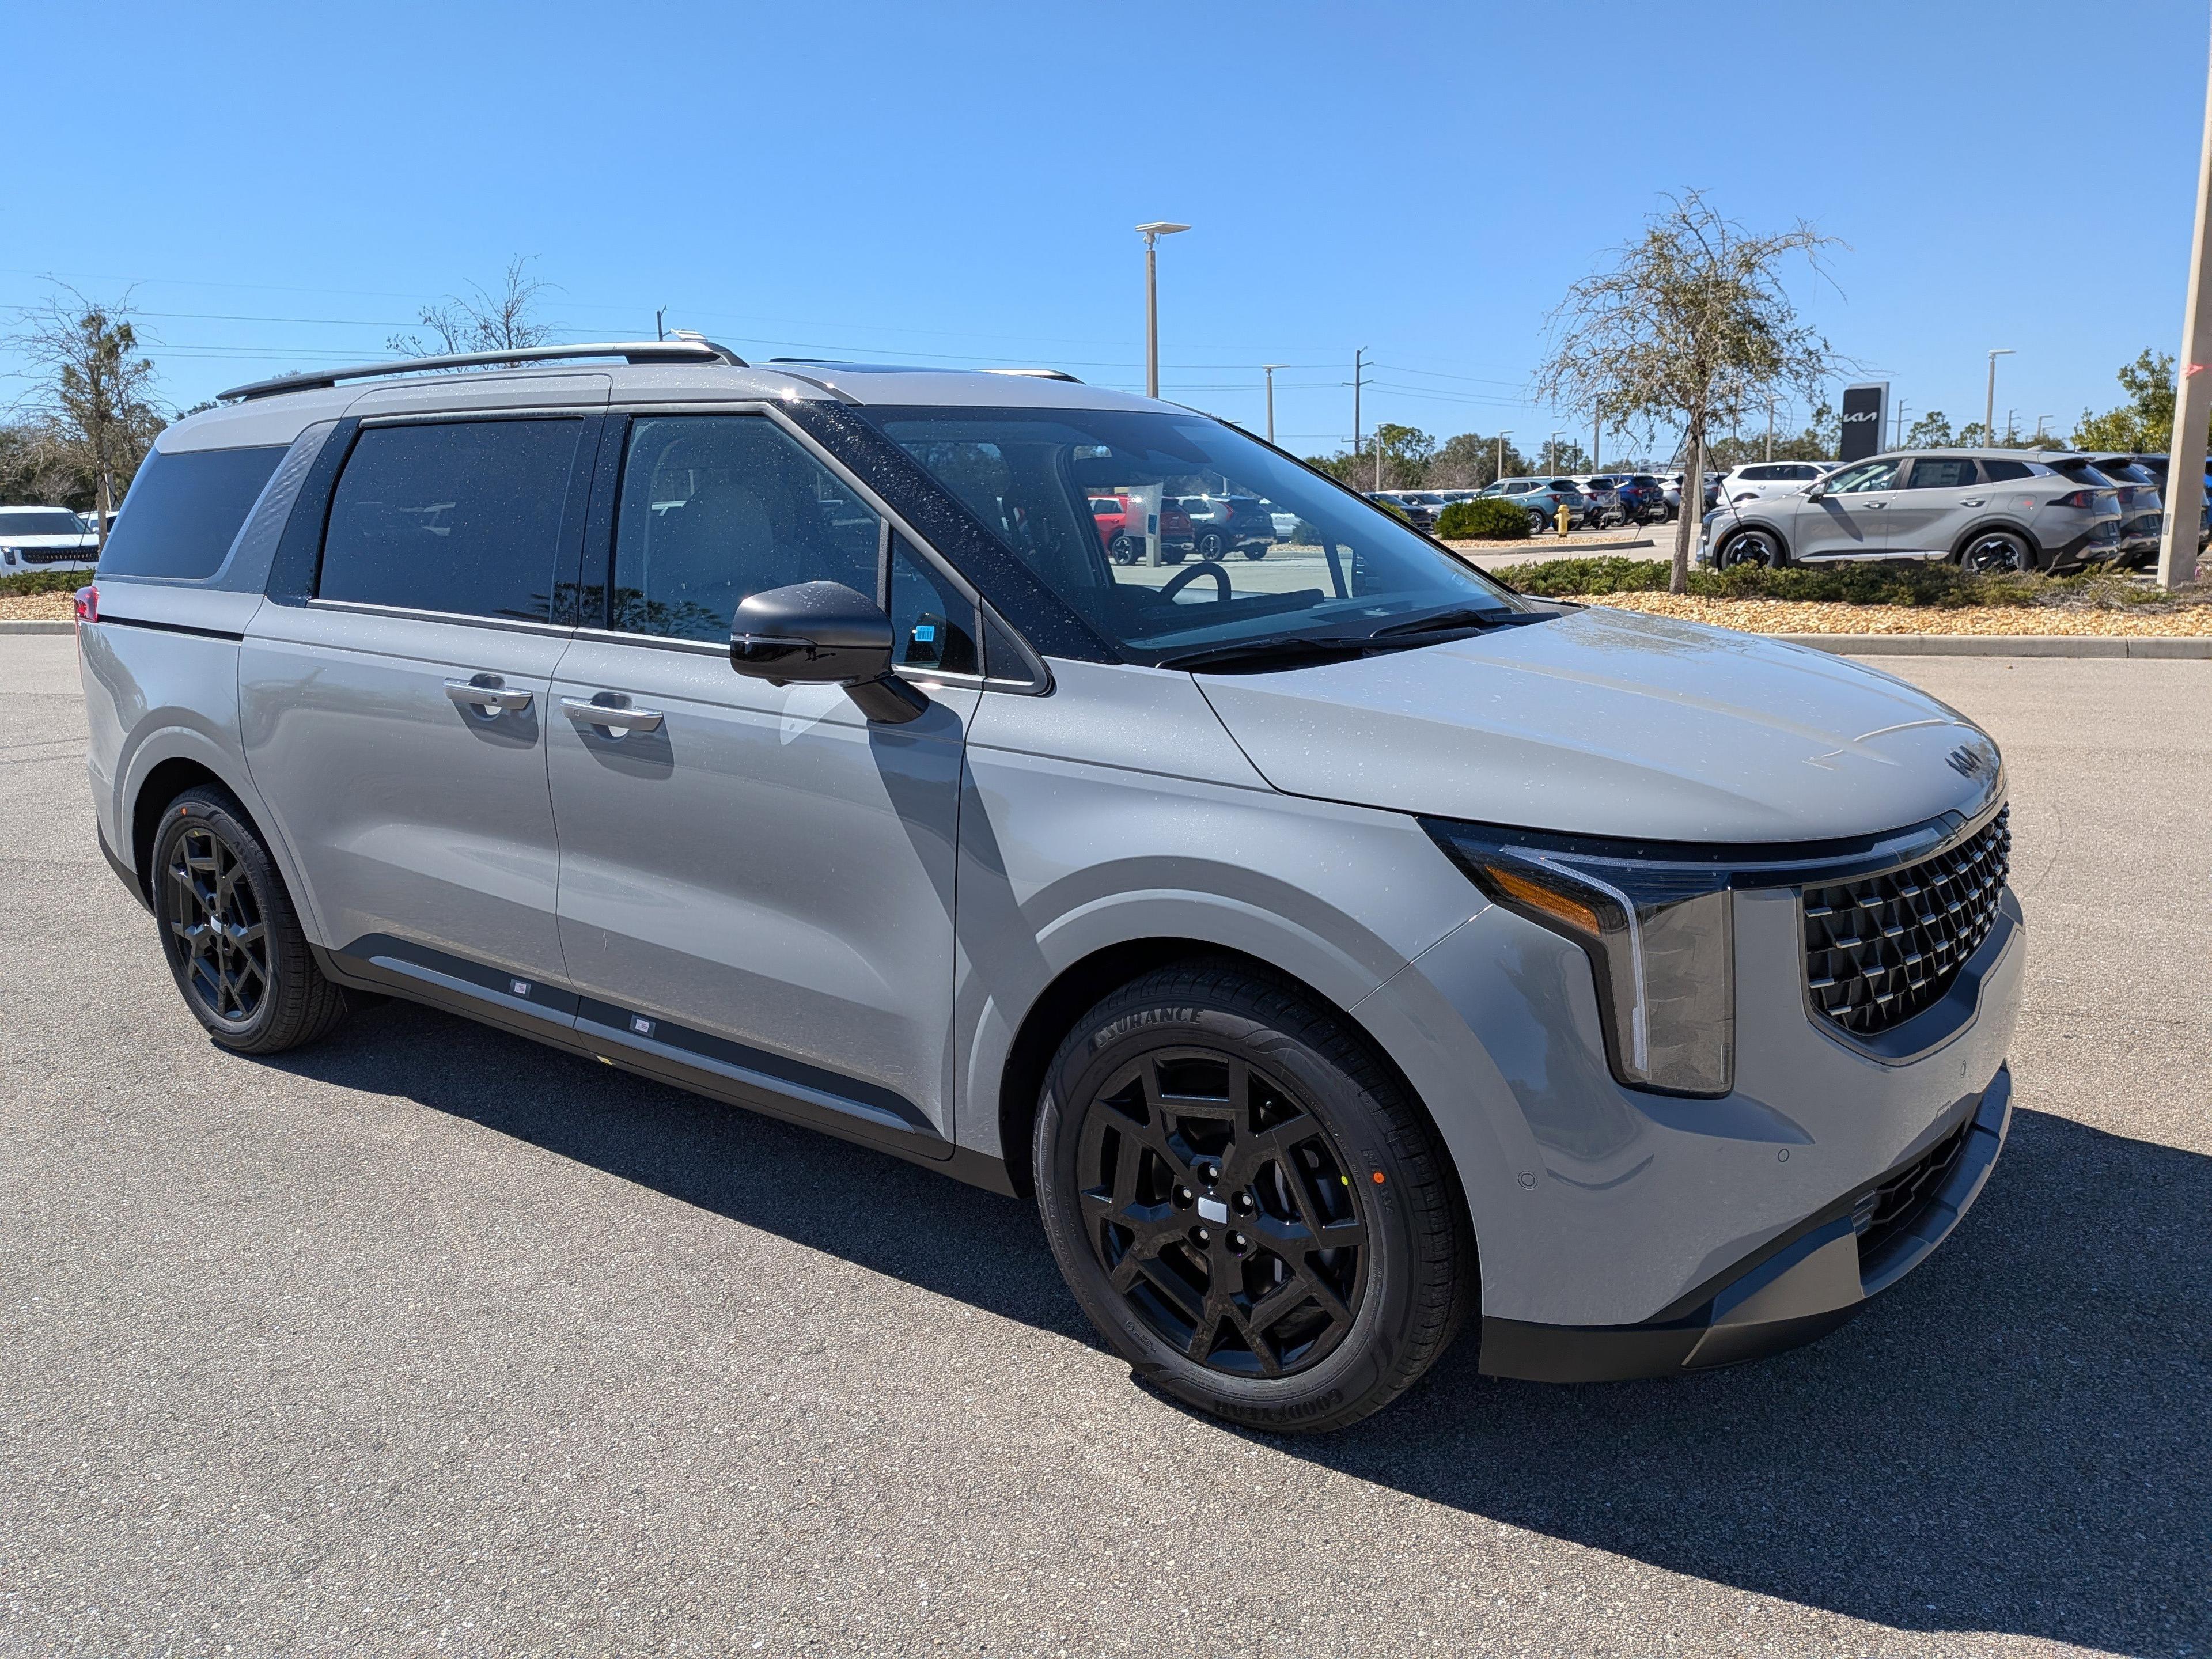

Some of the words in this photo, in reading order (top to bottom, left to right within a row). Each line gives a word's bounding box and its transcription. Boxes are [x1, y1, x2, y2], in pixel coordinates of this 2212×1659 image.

[1843, 411, 1877, 423] KIA
[1088, 1007, 1205, 1056] ASSURANCE
[1213, 1388, 1344, 1423] GOODYEAR
